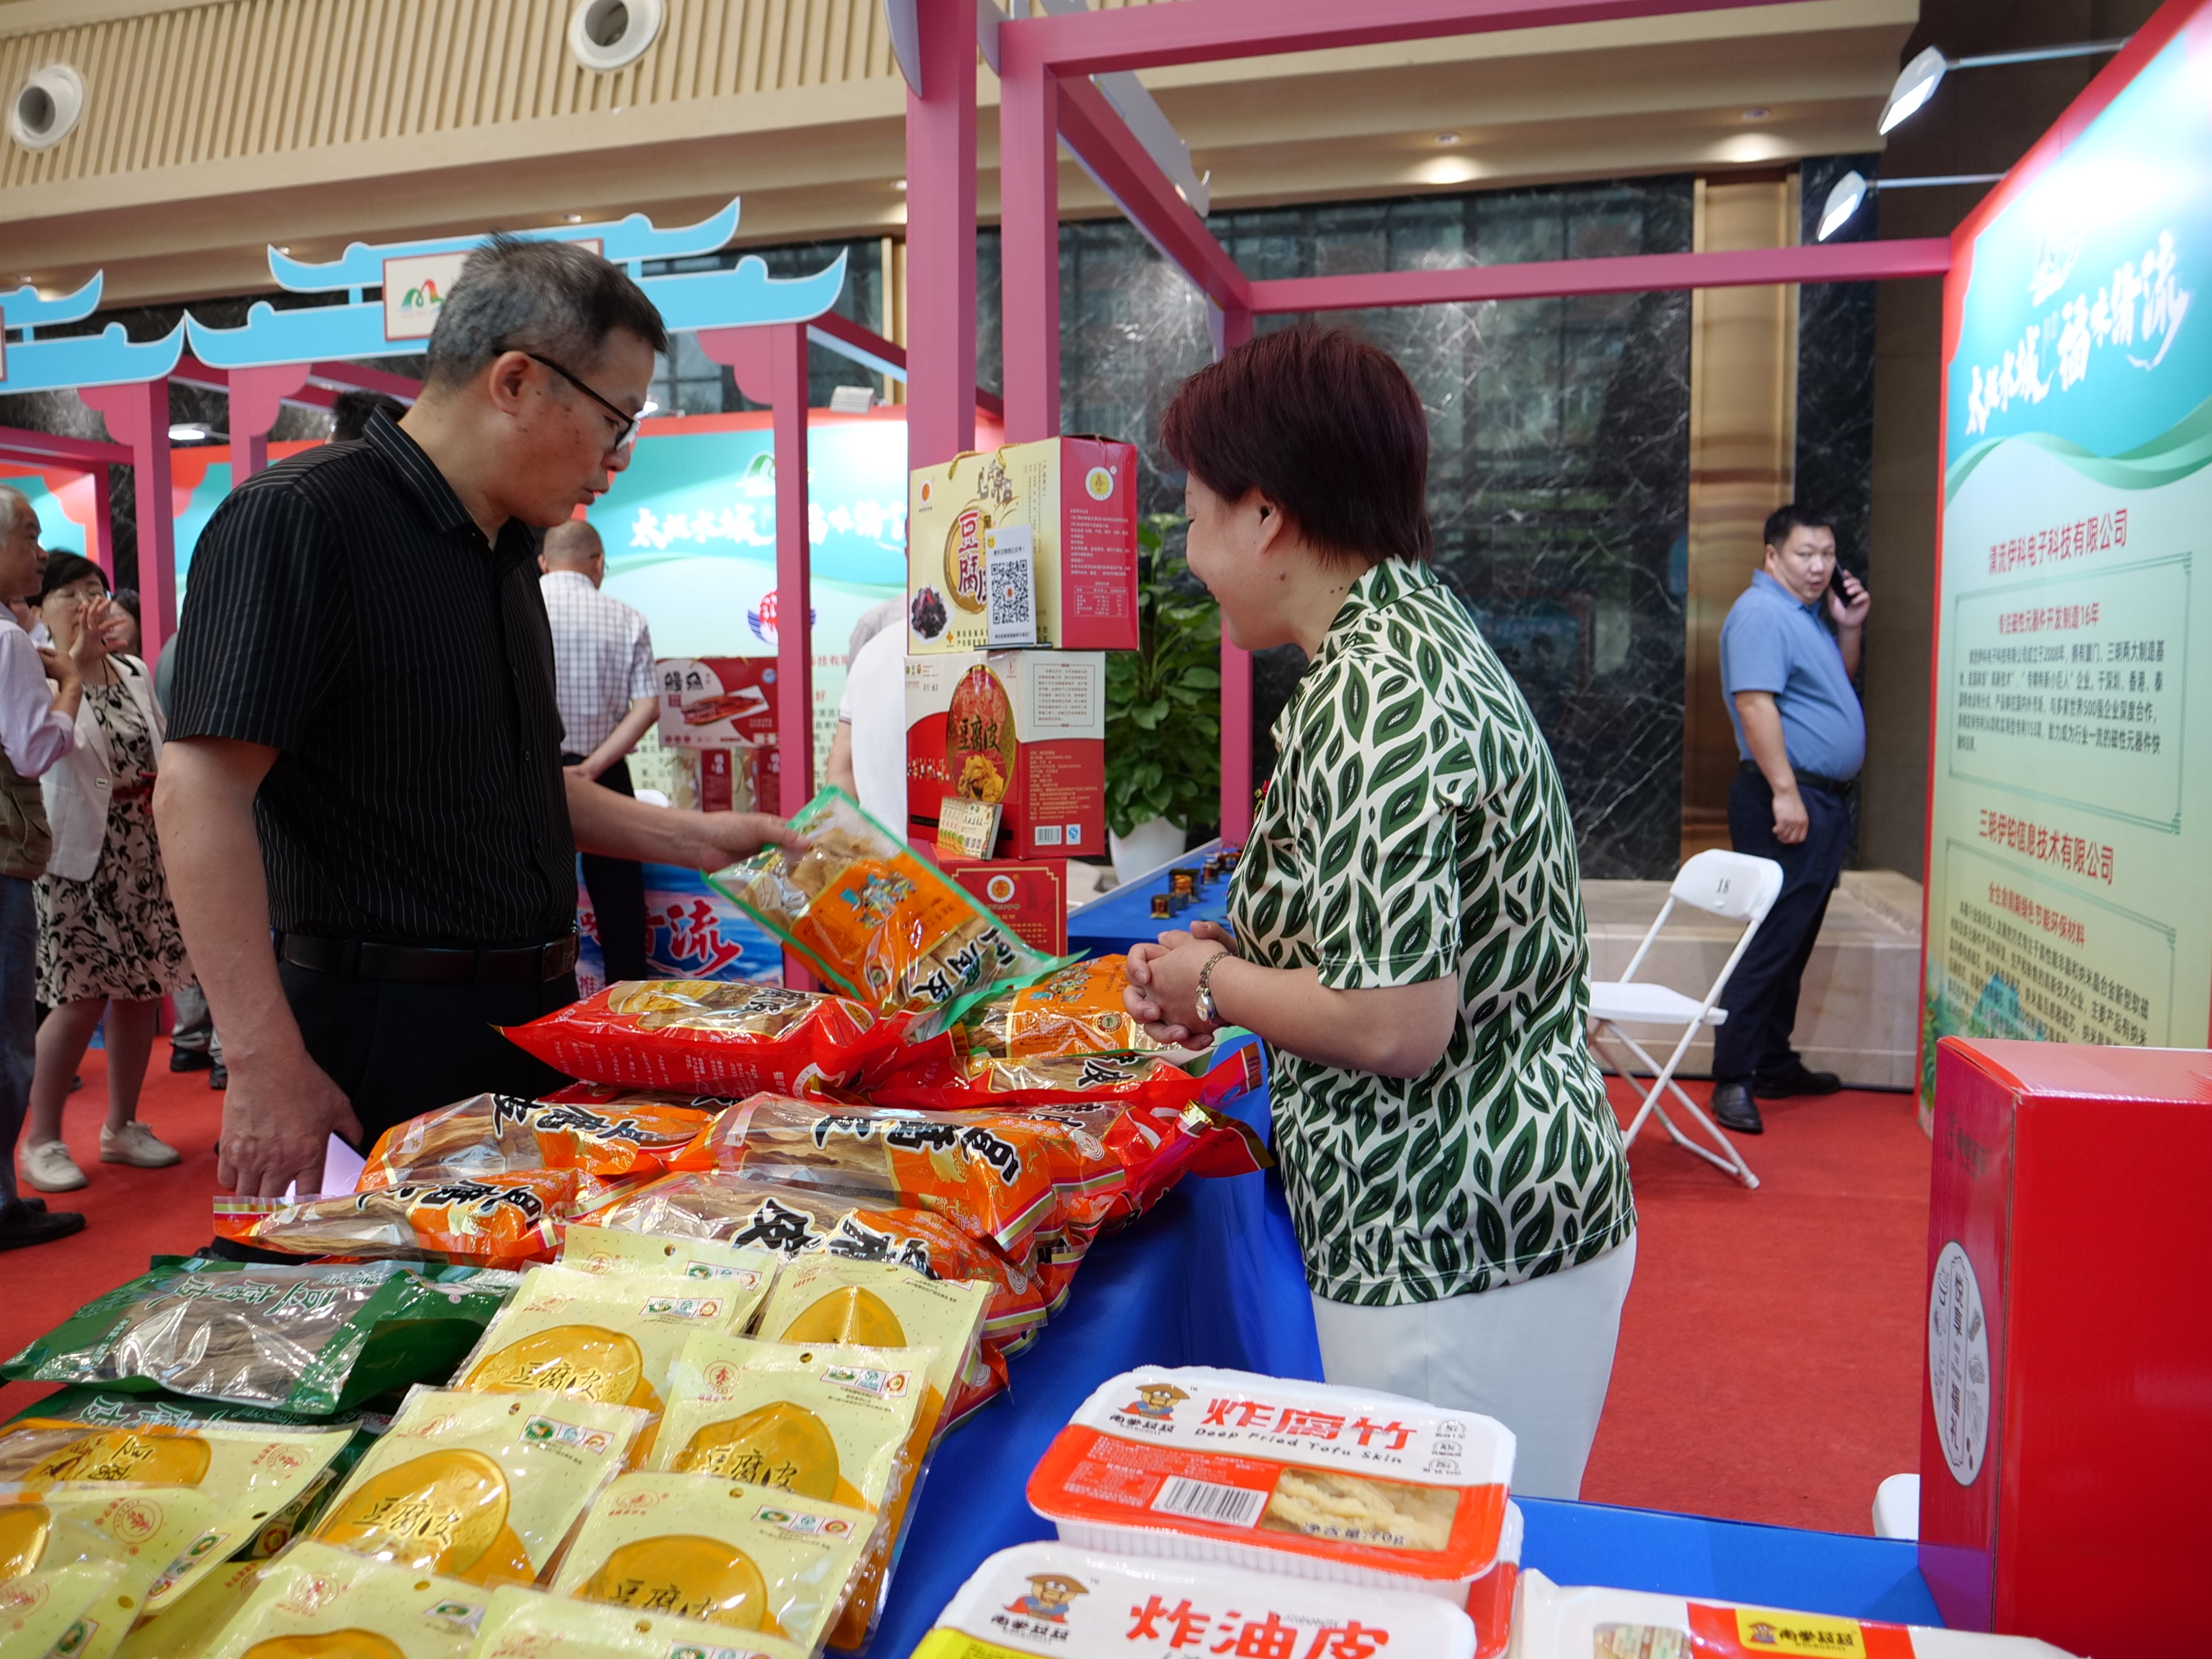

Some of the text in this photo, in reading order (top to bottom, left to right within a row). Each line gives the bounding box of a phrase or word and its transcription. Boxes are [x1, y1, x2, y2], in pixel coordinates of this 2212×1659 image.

[958, 714, 1000, 752] 豆腐皮
[504, 1360, 603, 1402] 豆腐皮
[1194, 1428, 1239, 1440] Deep
[1248, 1432, 1298, 1448] Fried
[1309, 1441, 1352, 1457] Tofu
[1361, 1450, 1403, 1465] Skin
[1200, 1398, 1417, 1450] 炸腐竹
[700, 1445, 799, 1494] 豆腐皮
[353, 1496, 462, 1545] 豆腐皮
[1125, 1595, 1390, 1659] 炸油皮
